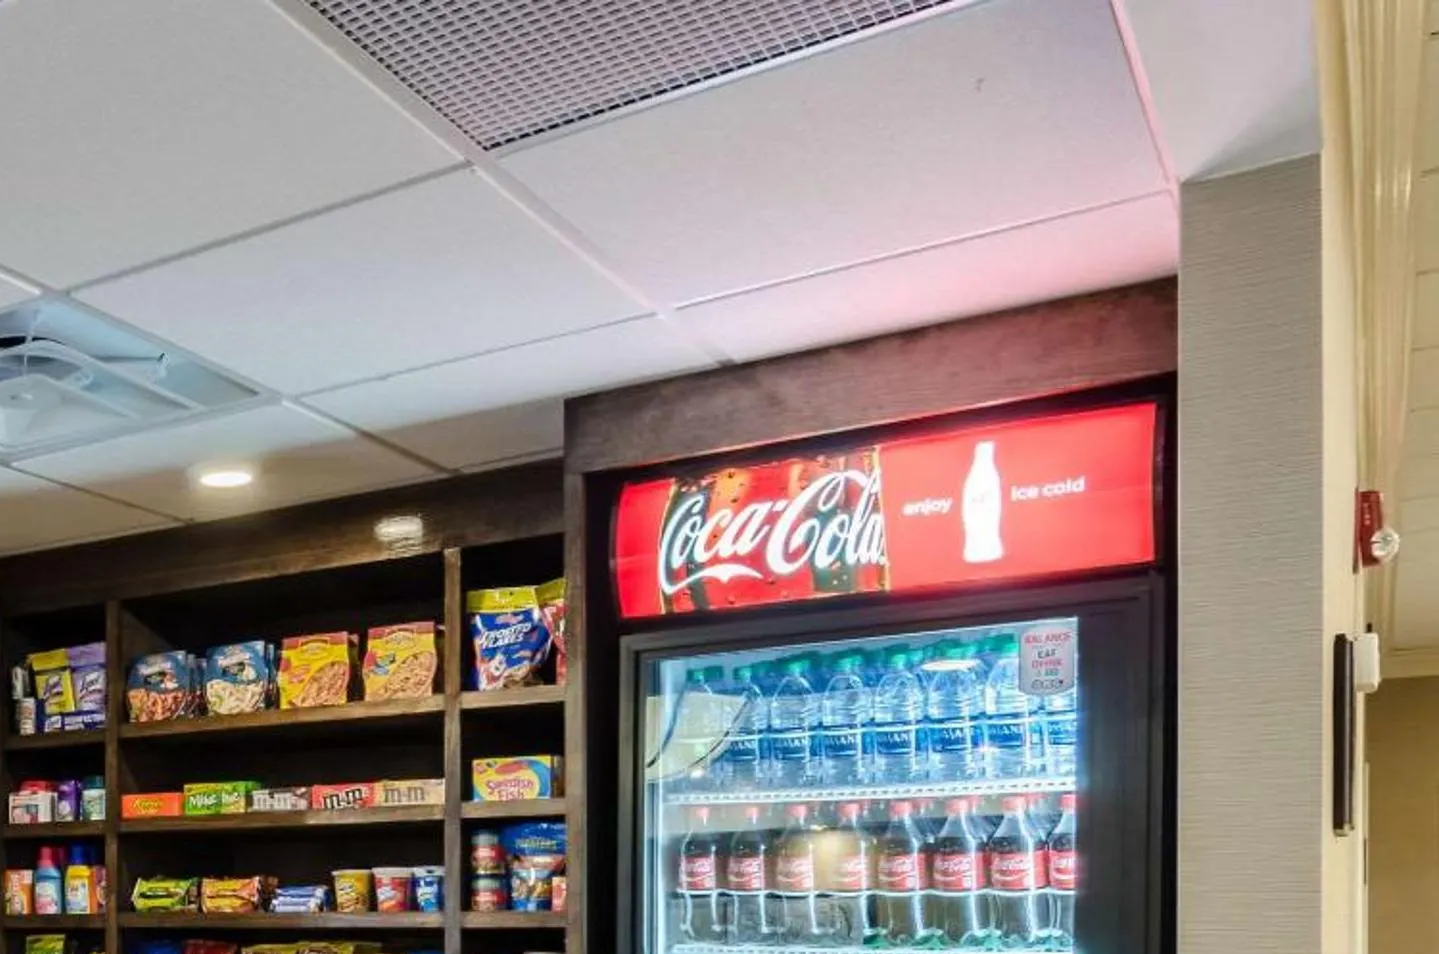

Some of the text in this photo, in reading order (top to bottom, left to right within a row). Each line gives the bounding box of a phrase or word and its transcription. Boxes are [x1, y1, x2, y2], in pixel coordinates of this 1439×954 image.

[1042, 475, 1086, 498] cold
[902, 497, 953, 516] enjoy
[658, 468, 888, 594] Coca-Cola
